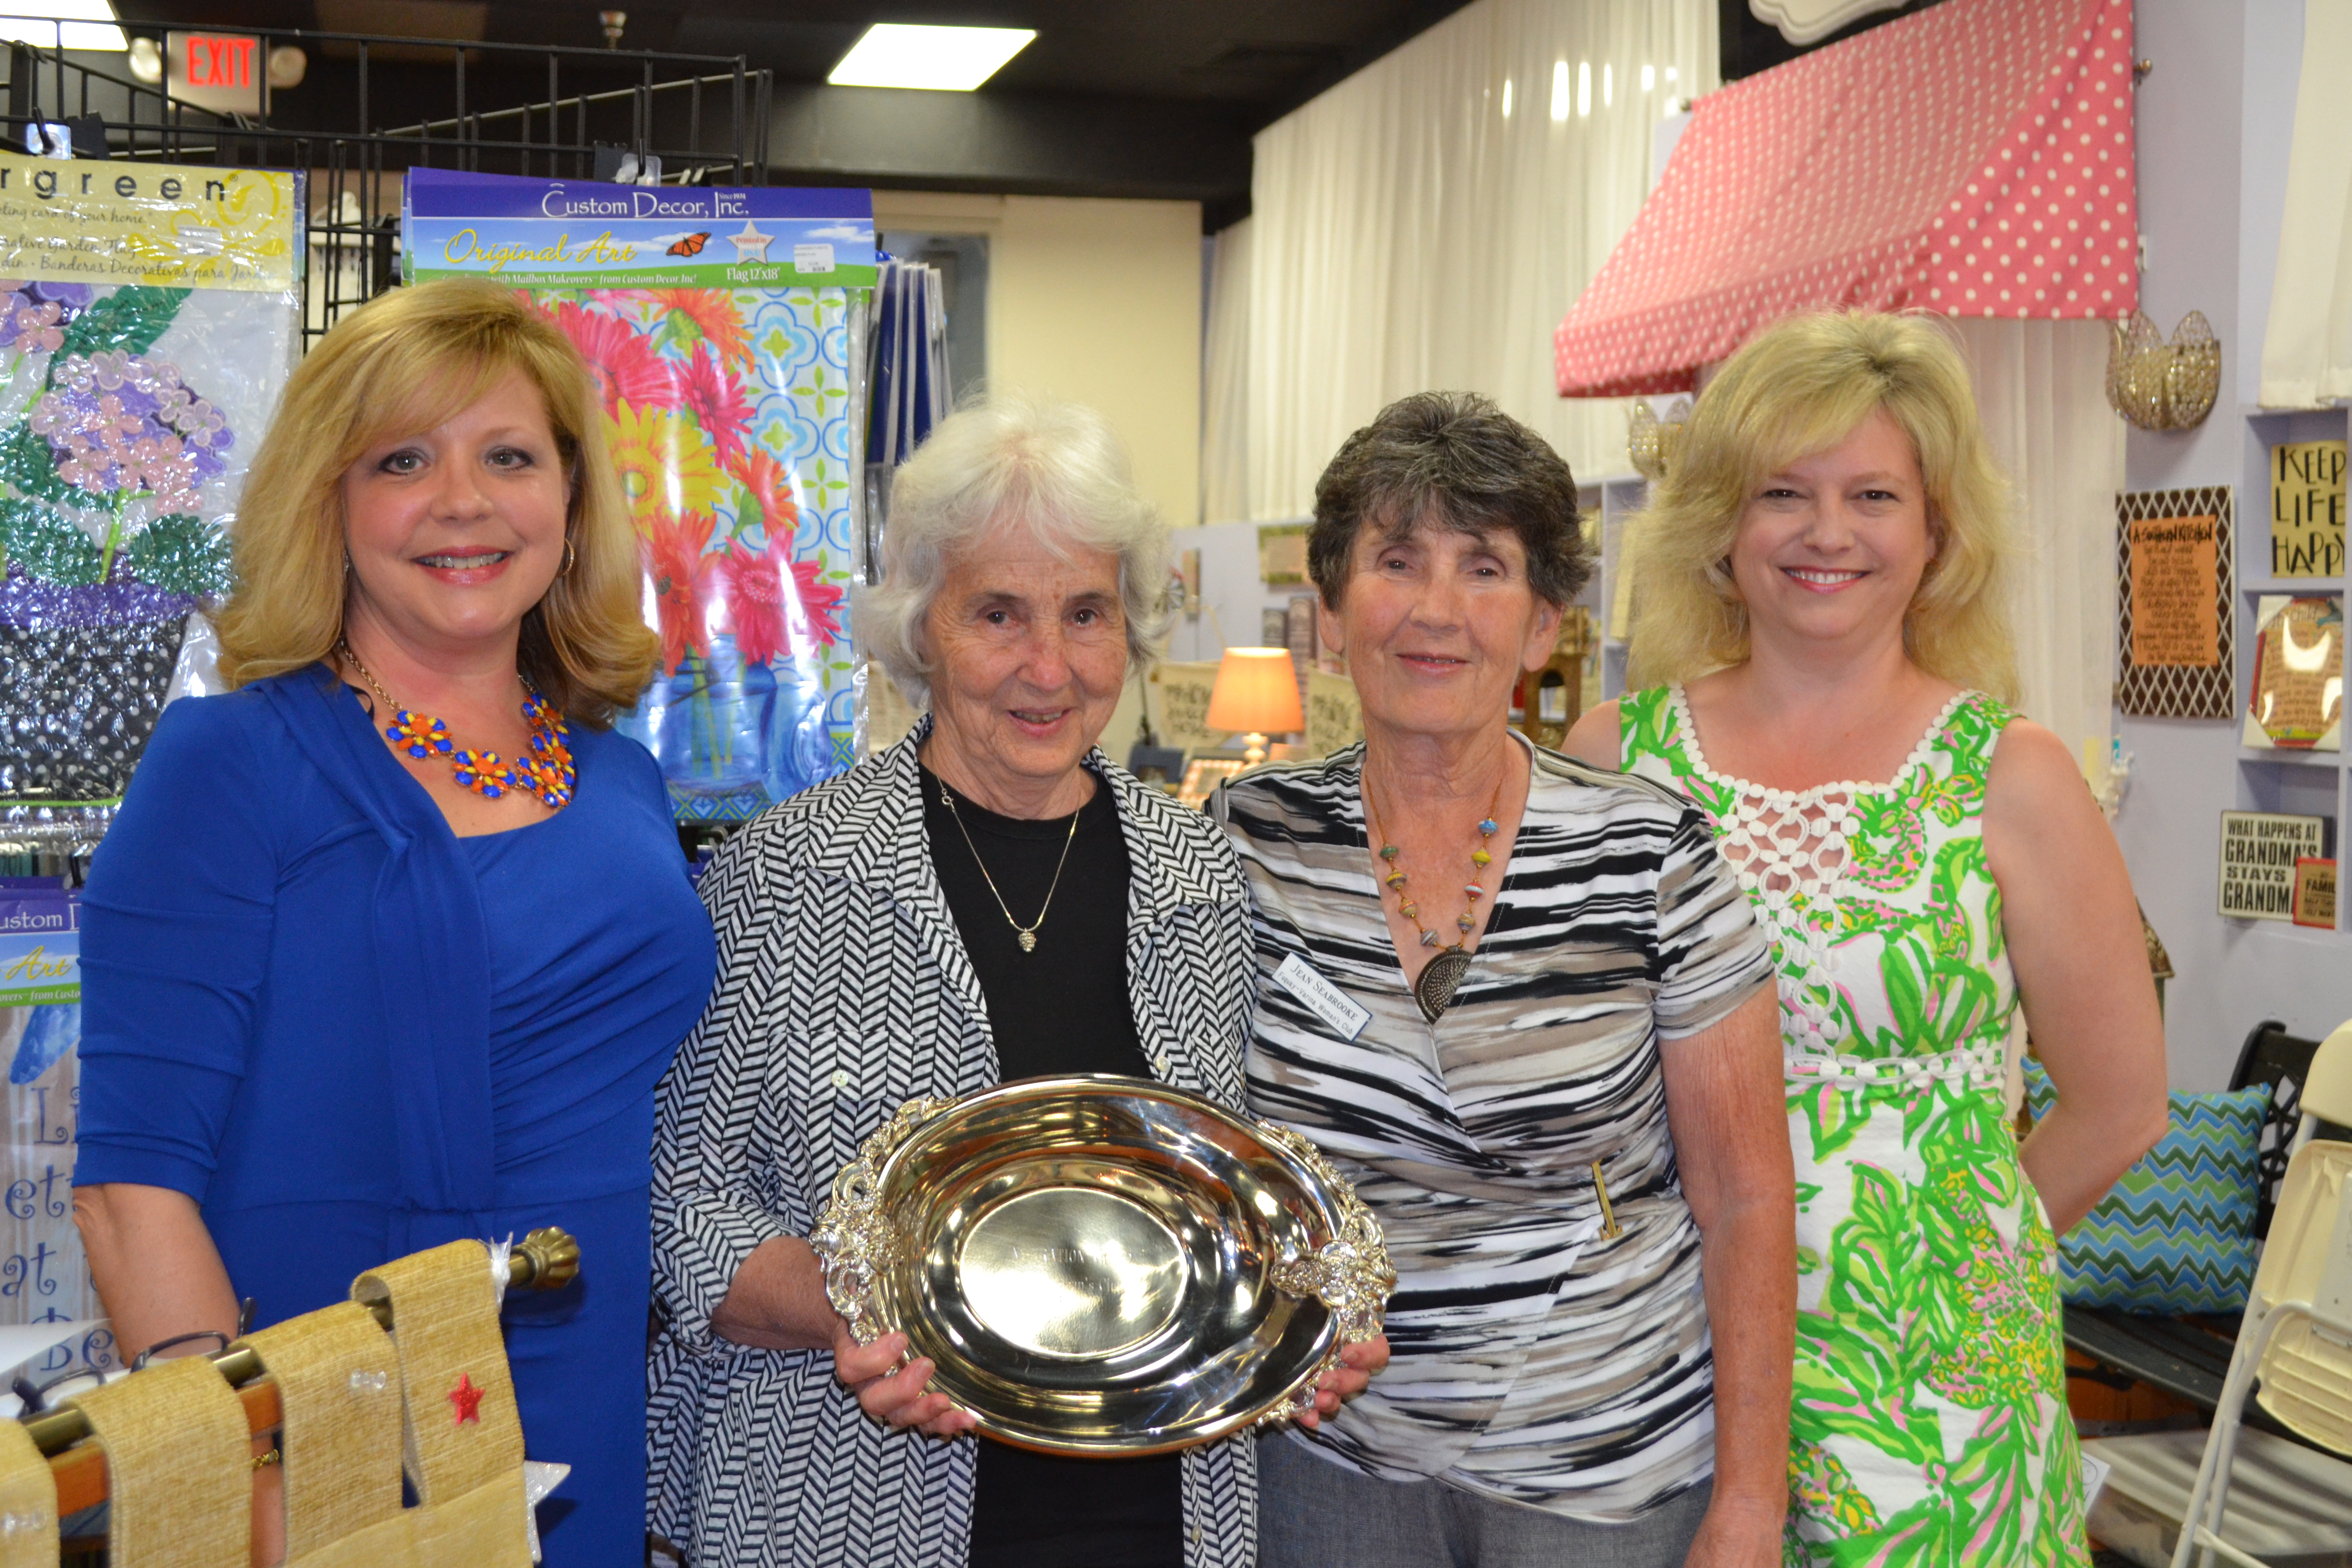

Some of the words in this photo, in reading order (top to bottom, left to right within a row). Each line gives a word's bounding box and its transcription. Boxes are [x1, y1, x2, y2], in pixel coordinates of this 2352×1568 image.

[187, 37, 255, 88] EXIT
[542, 183, 628, 218] Custom
[632, 192, 709, 218] Decor,
[715, 191, 749, 218] Inc.
[40, 255, 106, 273] Banderas
[444, 228, 572, 275] Original
[576, 230, 638, 264] Art
[513, 274, 546, 284] Mailbox
[549, 274, 593, 284] Makeovers
[600, 274, 621, 285] from
[622, 274, 654, 284] Custom
[726, 267, 749, 283] Flag
[2280, 446, 2346, 485] KEEP
[2276, 486, 2345, 528] LIFE
[2227, 818, 2254, 836] WHAT
[2258, 820, 2301, 840] HAPPENS
[2306, 823, 2316, 841] AT
[2226, 866, 2286, 883] STAYS
[2223, 881, 2294, 914] GRANDM
[6, 945, 72, 979] Art
[31, 989, 54, 1002] from
[1277, 971, 1316, 1006] Fuquay-Varina
[1318, 1003, 1340, 1025] Woman's
[1341, 1022, 1354, 1035] Club
[1290, 964, 1313, 985] JEAN
[1313, 980, 1358, 1021] SEABROOKE
[2, 1242, 57, 1297] at
